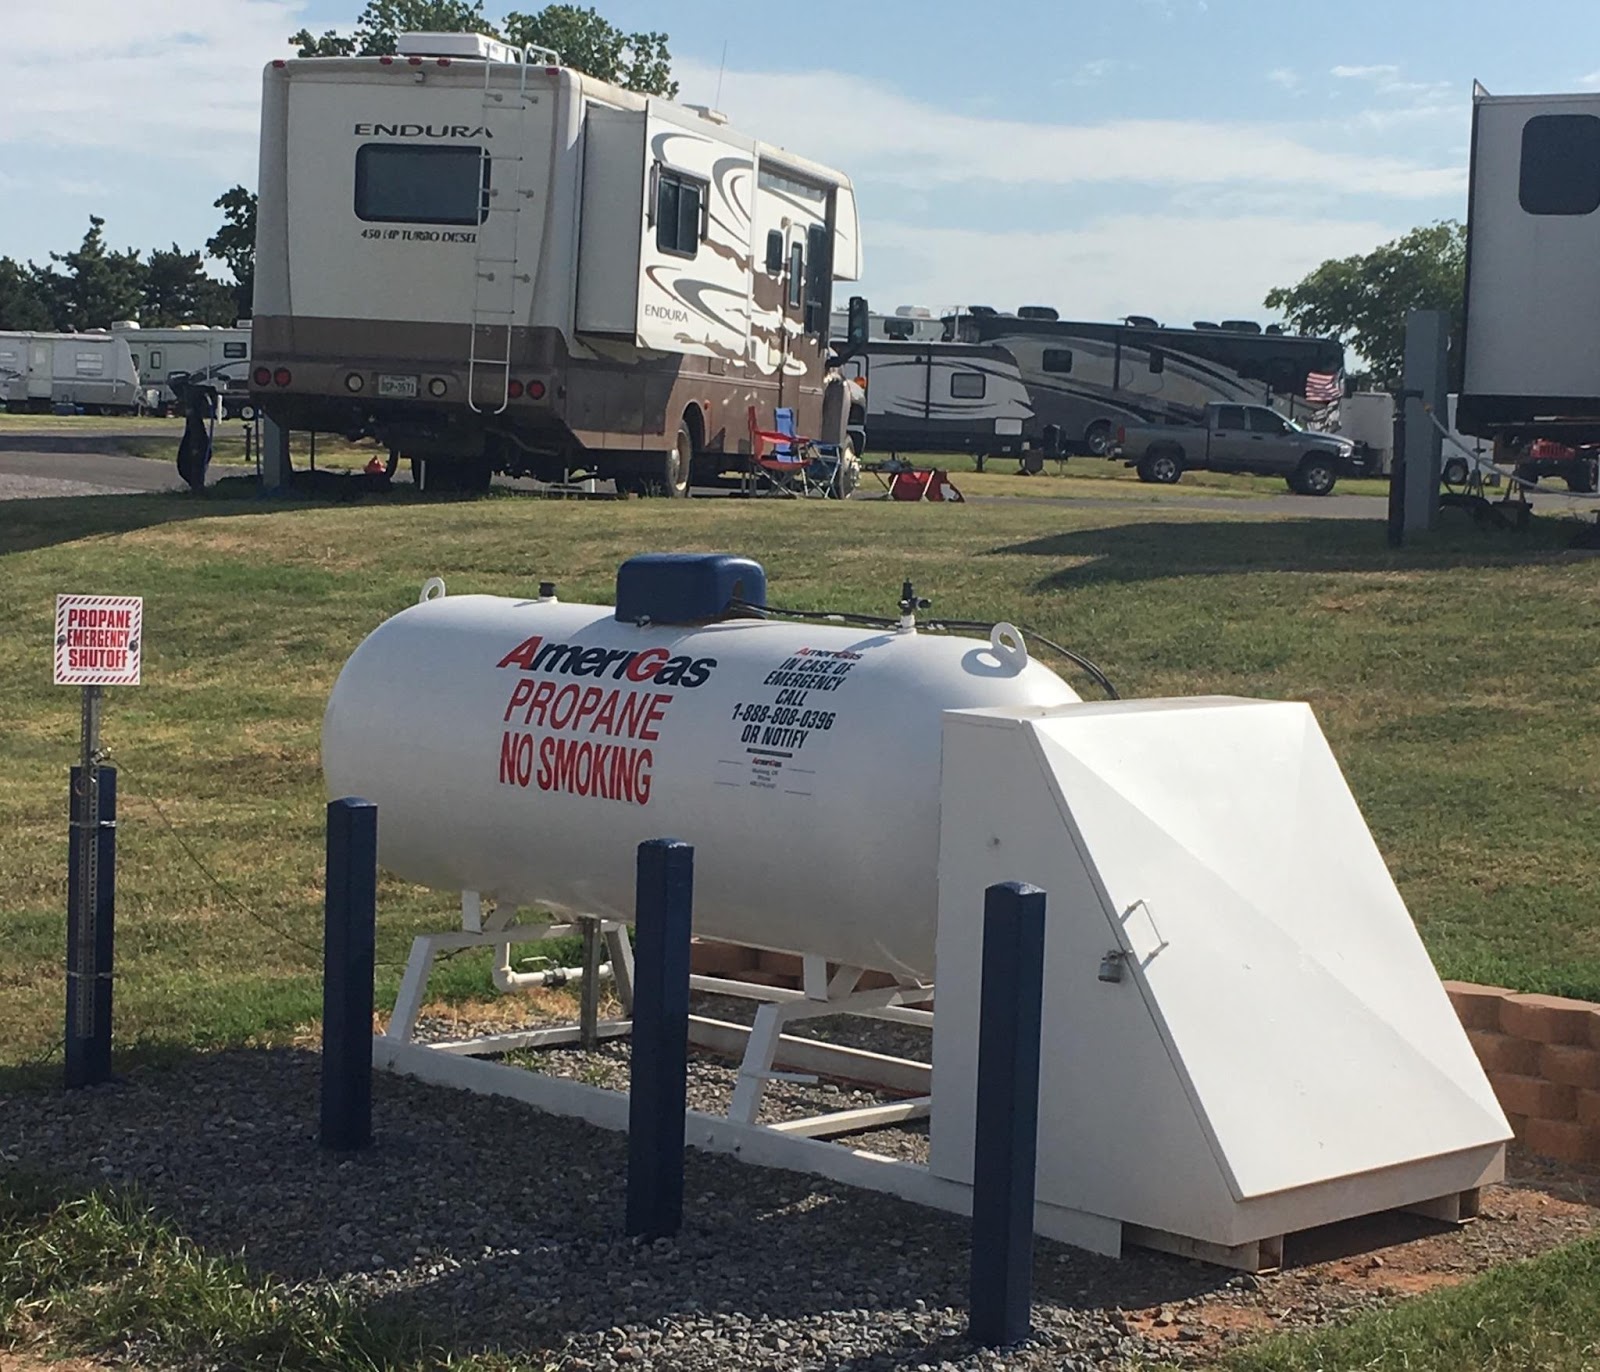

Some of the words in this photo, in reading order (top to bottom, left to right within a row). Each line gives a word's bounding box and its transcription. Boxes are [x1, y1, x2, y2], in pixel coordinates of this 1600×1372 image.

[354, 123, 494, 138] ENDURA
[361, 229, 381, 239] 450
[402, 230, 439, 241] TURBO
[645, 304, 688, 322] ENDURA
[68, 609, 132, 628] PROPANE
[67, 629, 130, 648] EMERGENCY
[69, 649, 128, 668] SHUTOFF
[496, 635, 718, 688] AmeriGas
[779, 657, 801, 670] IN
[798, 659, 836, 674] CASE
[832, 662, 856, 675] OF
[763, 670, 846, 691] EMERGENCY
[775, 689, 808, 706] CALL
[504, 678, 674, 741] PROPANE
[732, 703, 836, 730] 1-888-808-0396
[741, 724, 761, 744] OR
[761, 726, 809, 749] NOTIFY
[500, 731, 534, 788] NO
[537, 736, 653, 805] SMOKING
